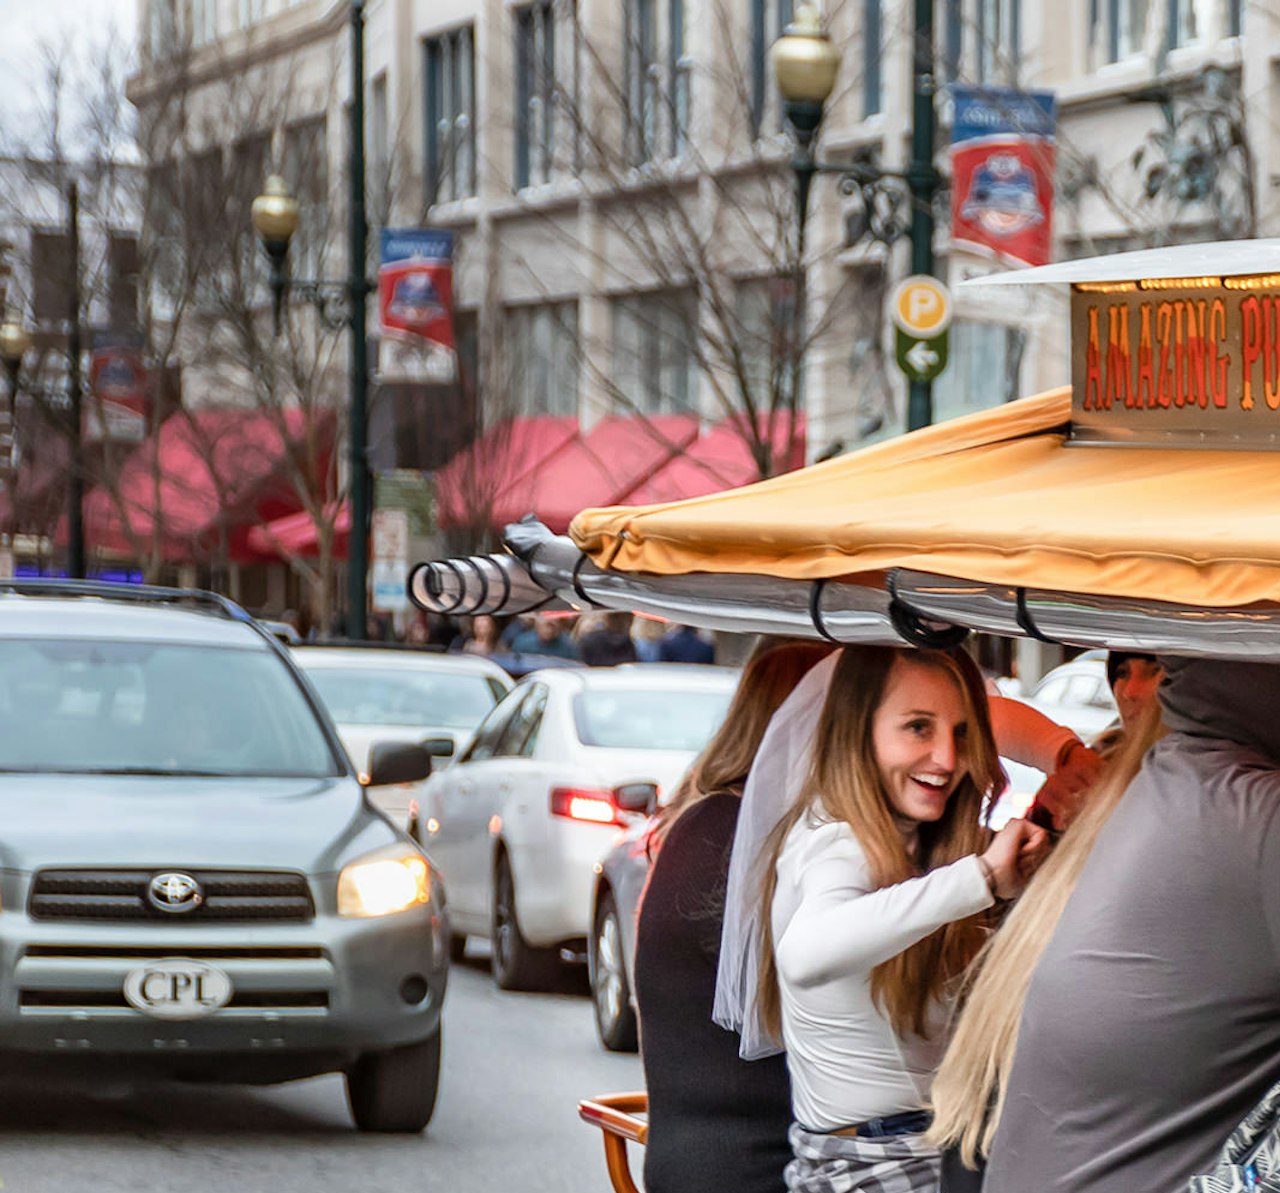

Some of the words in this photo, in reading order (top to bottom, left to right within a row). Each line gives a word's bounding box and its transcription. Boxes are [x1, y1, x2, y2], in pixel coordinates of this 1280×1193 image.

[908, 289, 937, 321] P
[1083, 298, 1231, 410] AMAZING
[139, 972, 217, 1005] CPL
